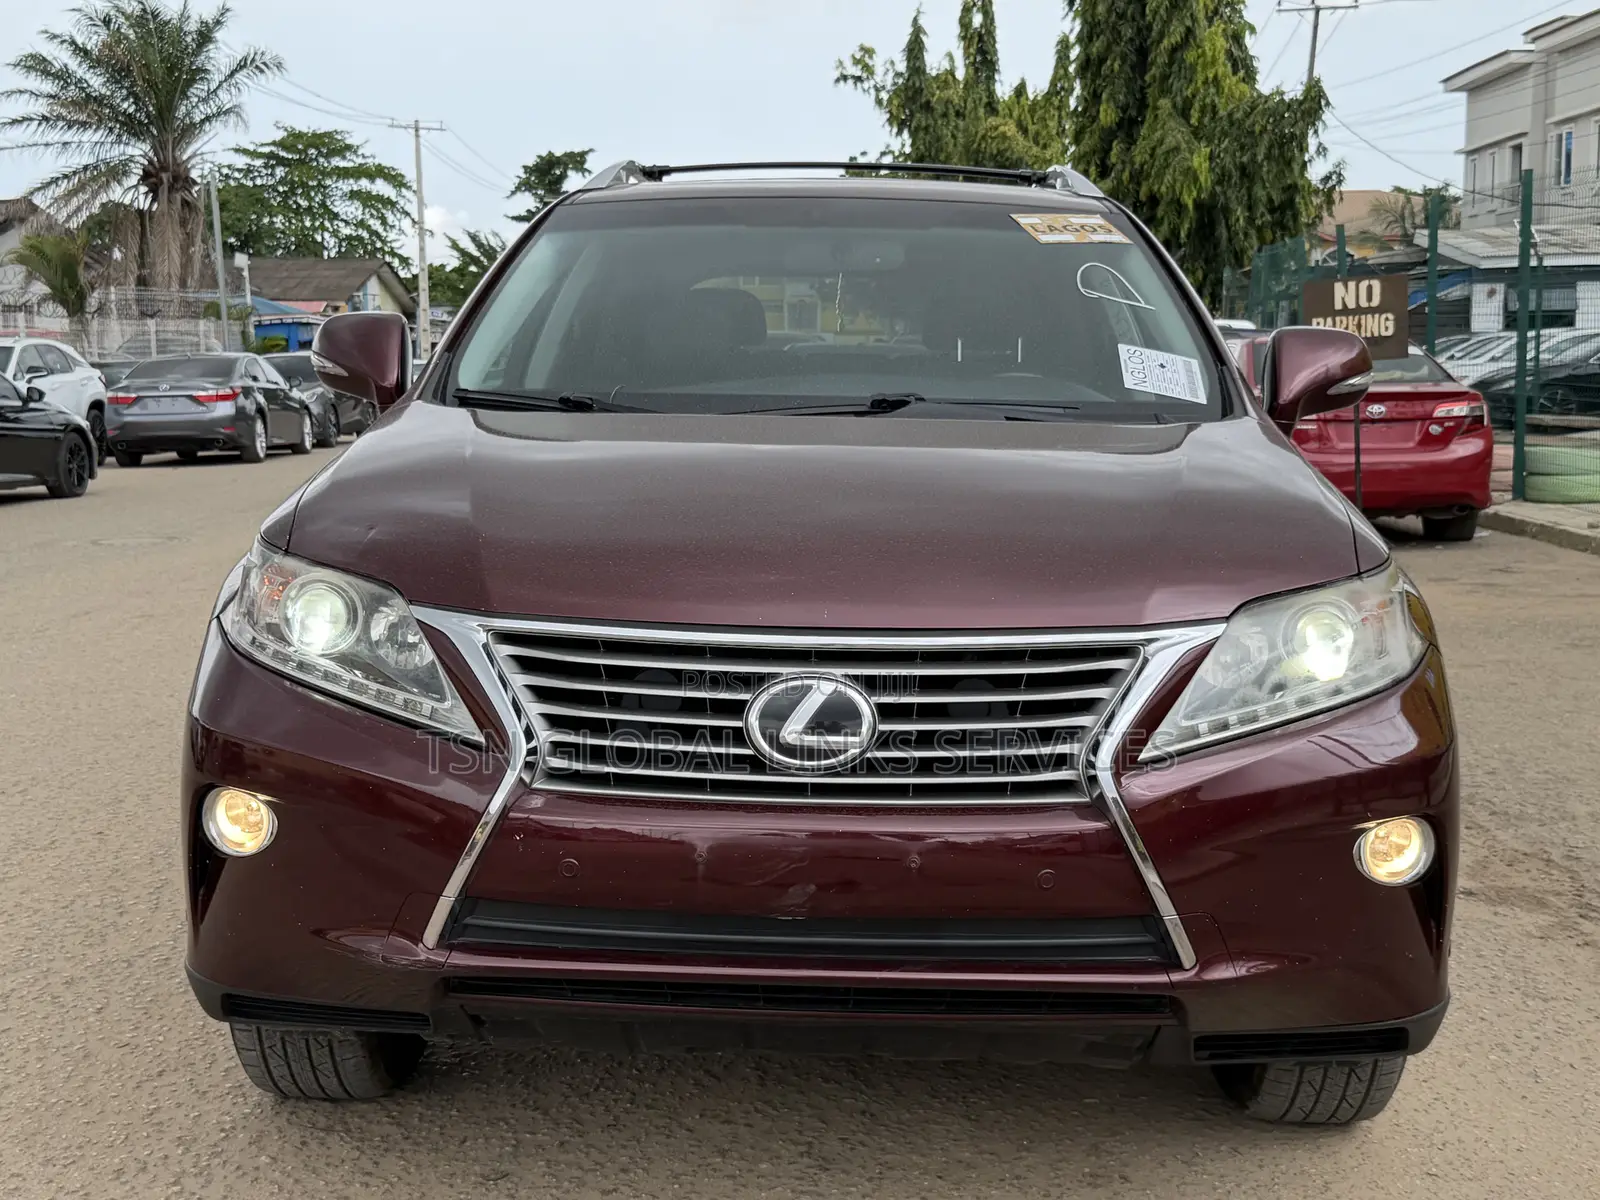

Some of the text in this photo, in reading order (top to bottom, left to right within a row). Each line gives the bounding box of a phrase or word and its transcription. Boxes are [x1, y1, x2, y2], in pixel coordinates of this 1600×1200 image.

[1029, 224, 1114, 234] LAGOS
[1333, 279, 1381, 310] NO
[1126, 348, 1149, 388] NGLOS
